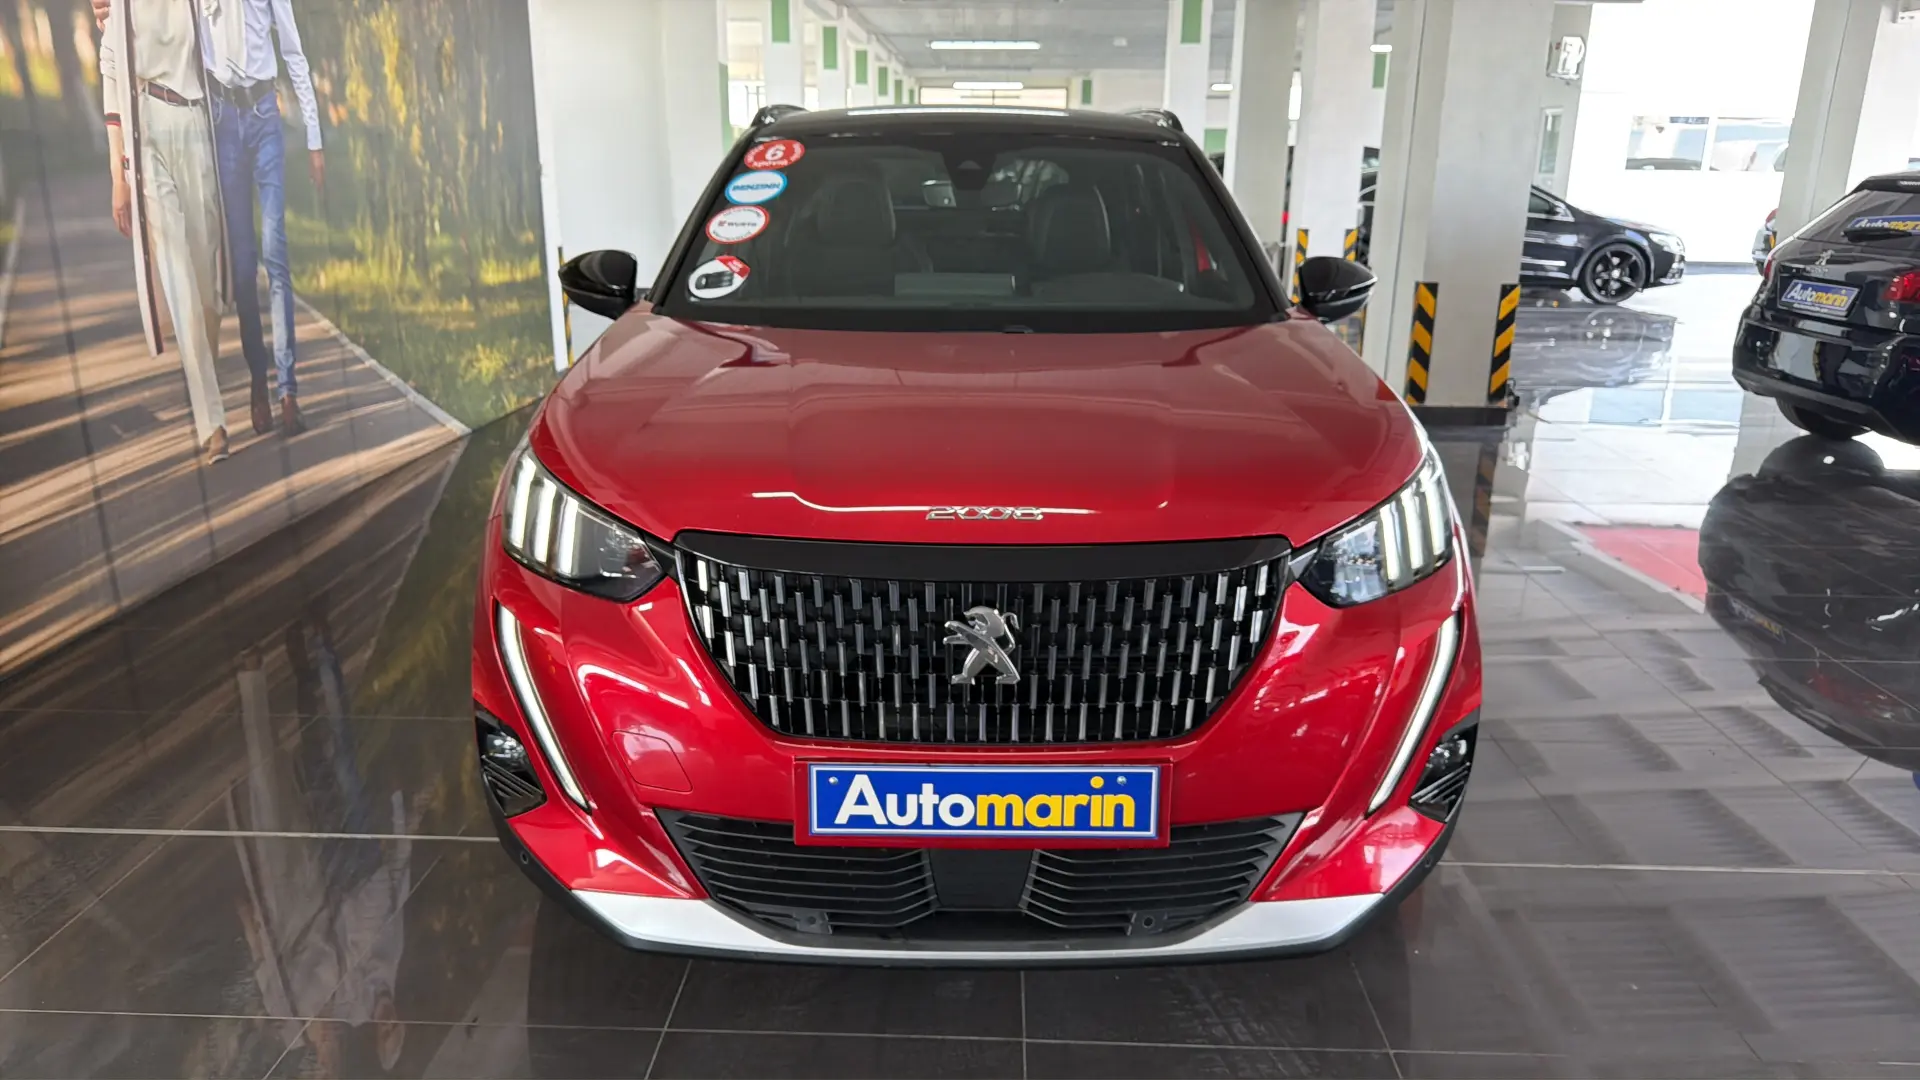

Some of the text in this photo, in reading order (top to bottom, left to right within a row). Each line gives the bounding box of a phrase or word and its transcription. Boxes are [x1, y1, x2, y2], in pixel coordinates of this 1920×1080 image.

[765, 143, 786, 161] 6
[1787, 283, 1848, 307] Automarin
[925, 505, 1044, 520] 2008
[834, 773, 1136, 828] Automarin
